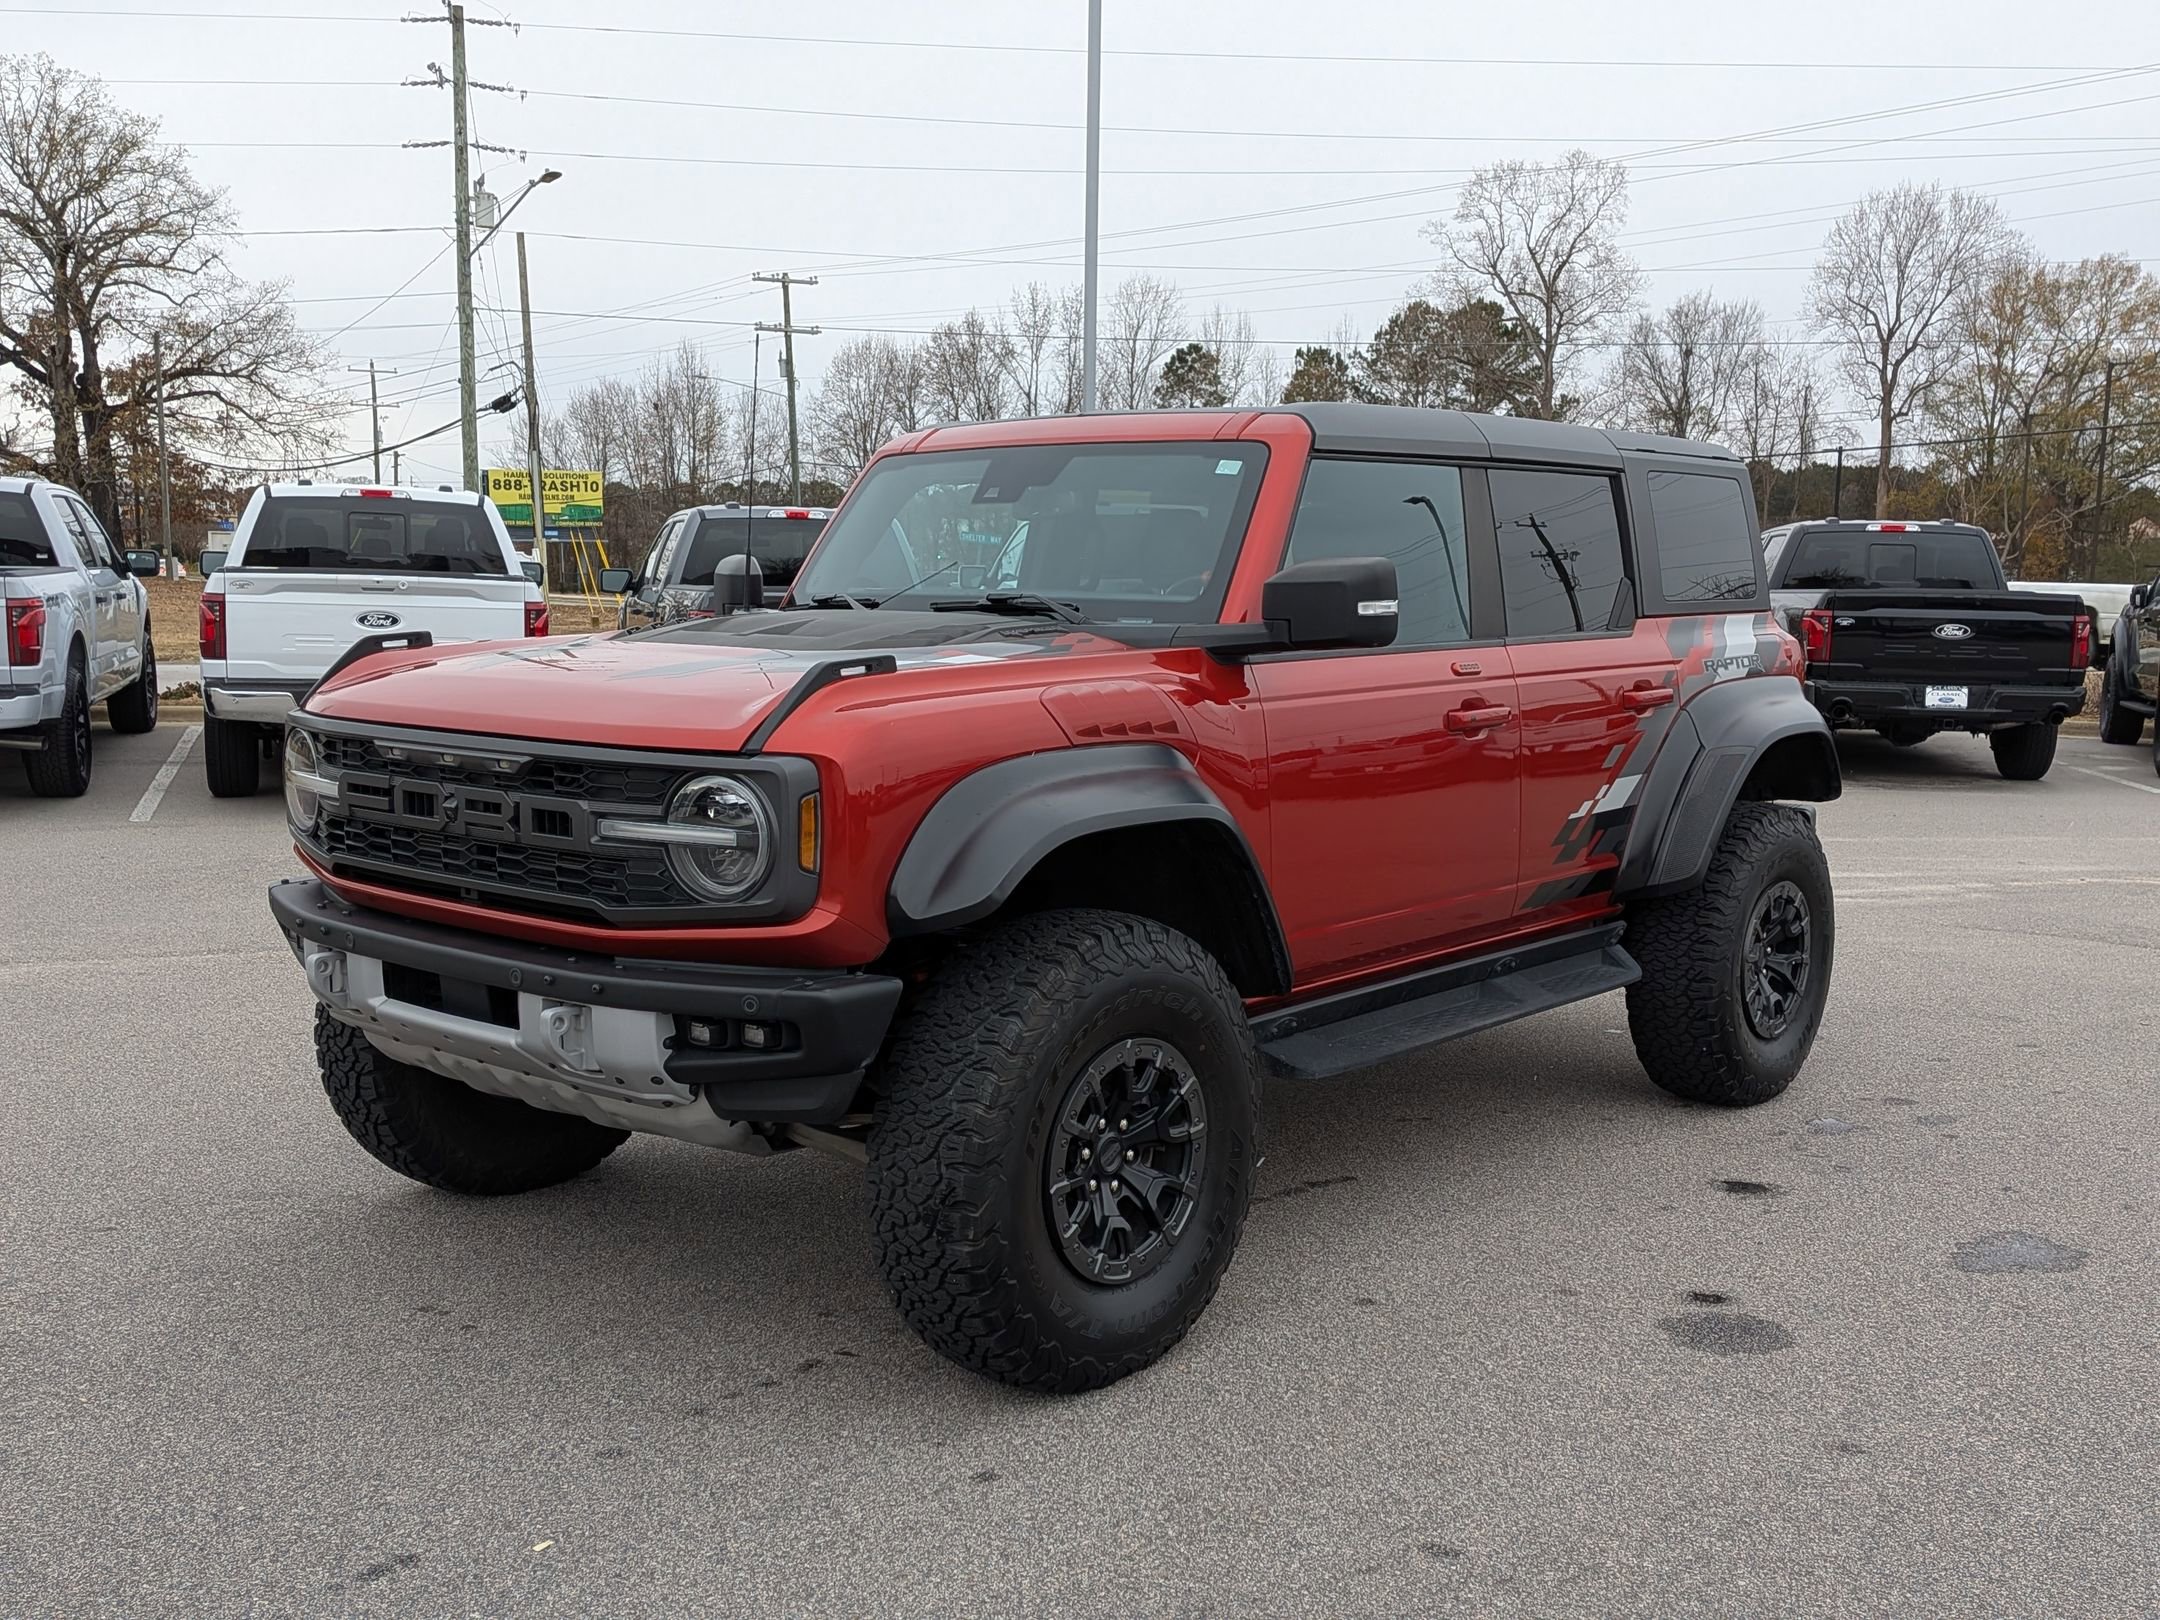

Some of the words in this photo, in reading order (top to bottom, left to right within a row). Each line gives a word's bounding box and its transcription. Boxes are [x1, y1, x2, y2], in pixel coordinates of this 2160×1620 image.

[503, 471, 530, 479] HAULI
[1703, 654, 1765, 679] RAPTOR
[339, 770, 589, 851] FORD
